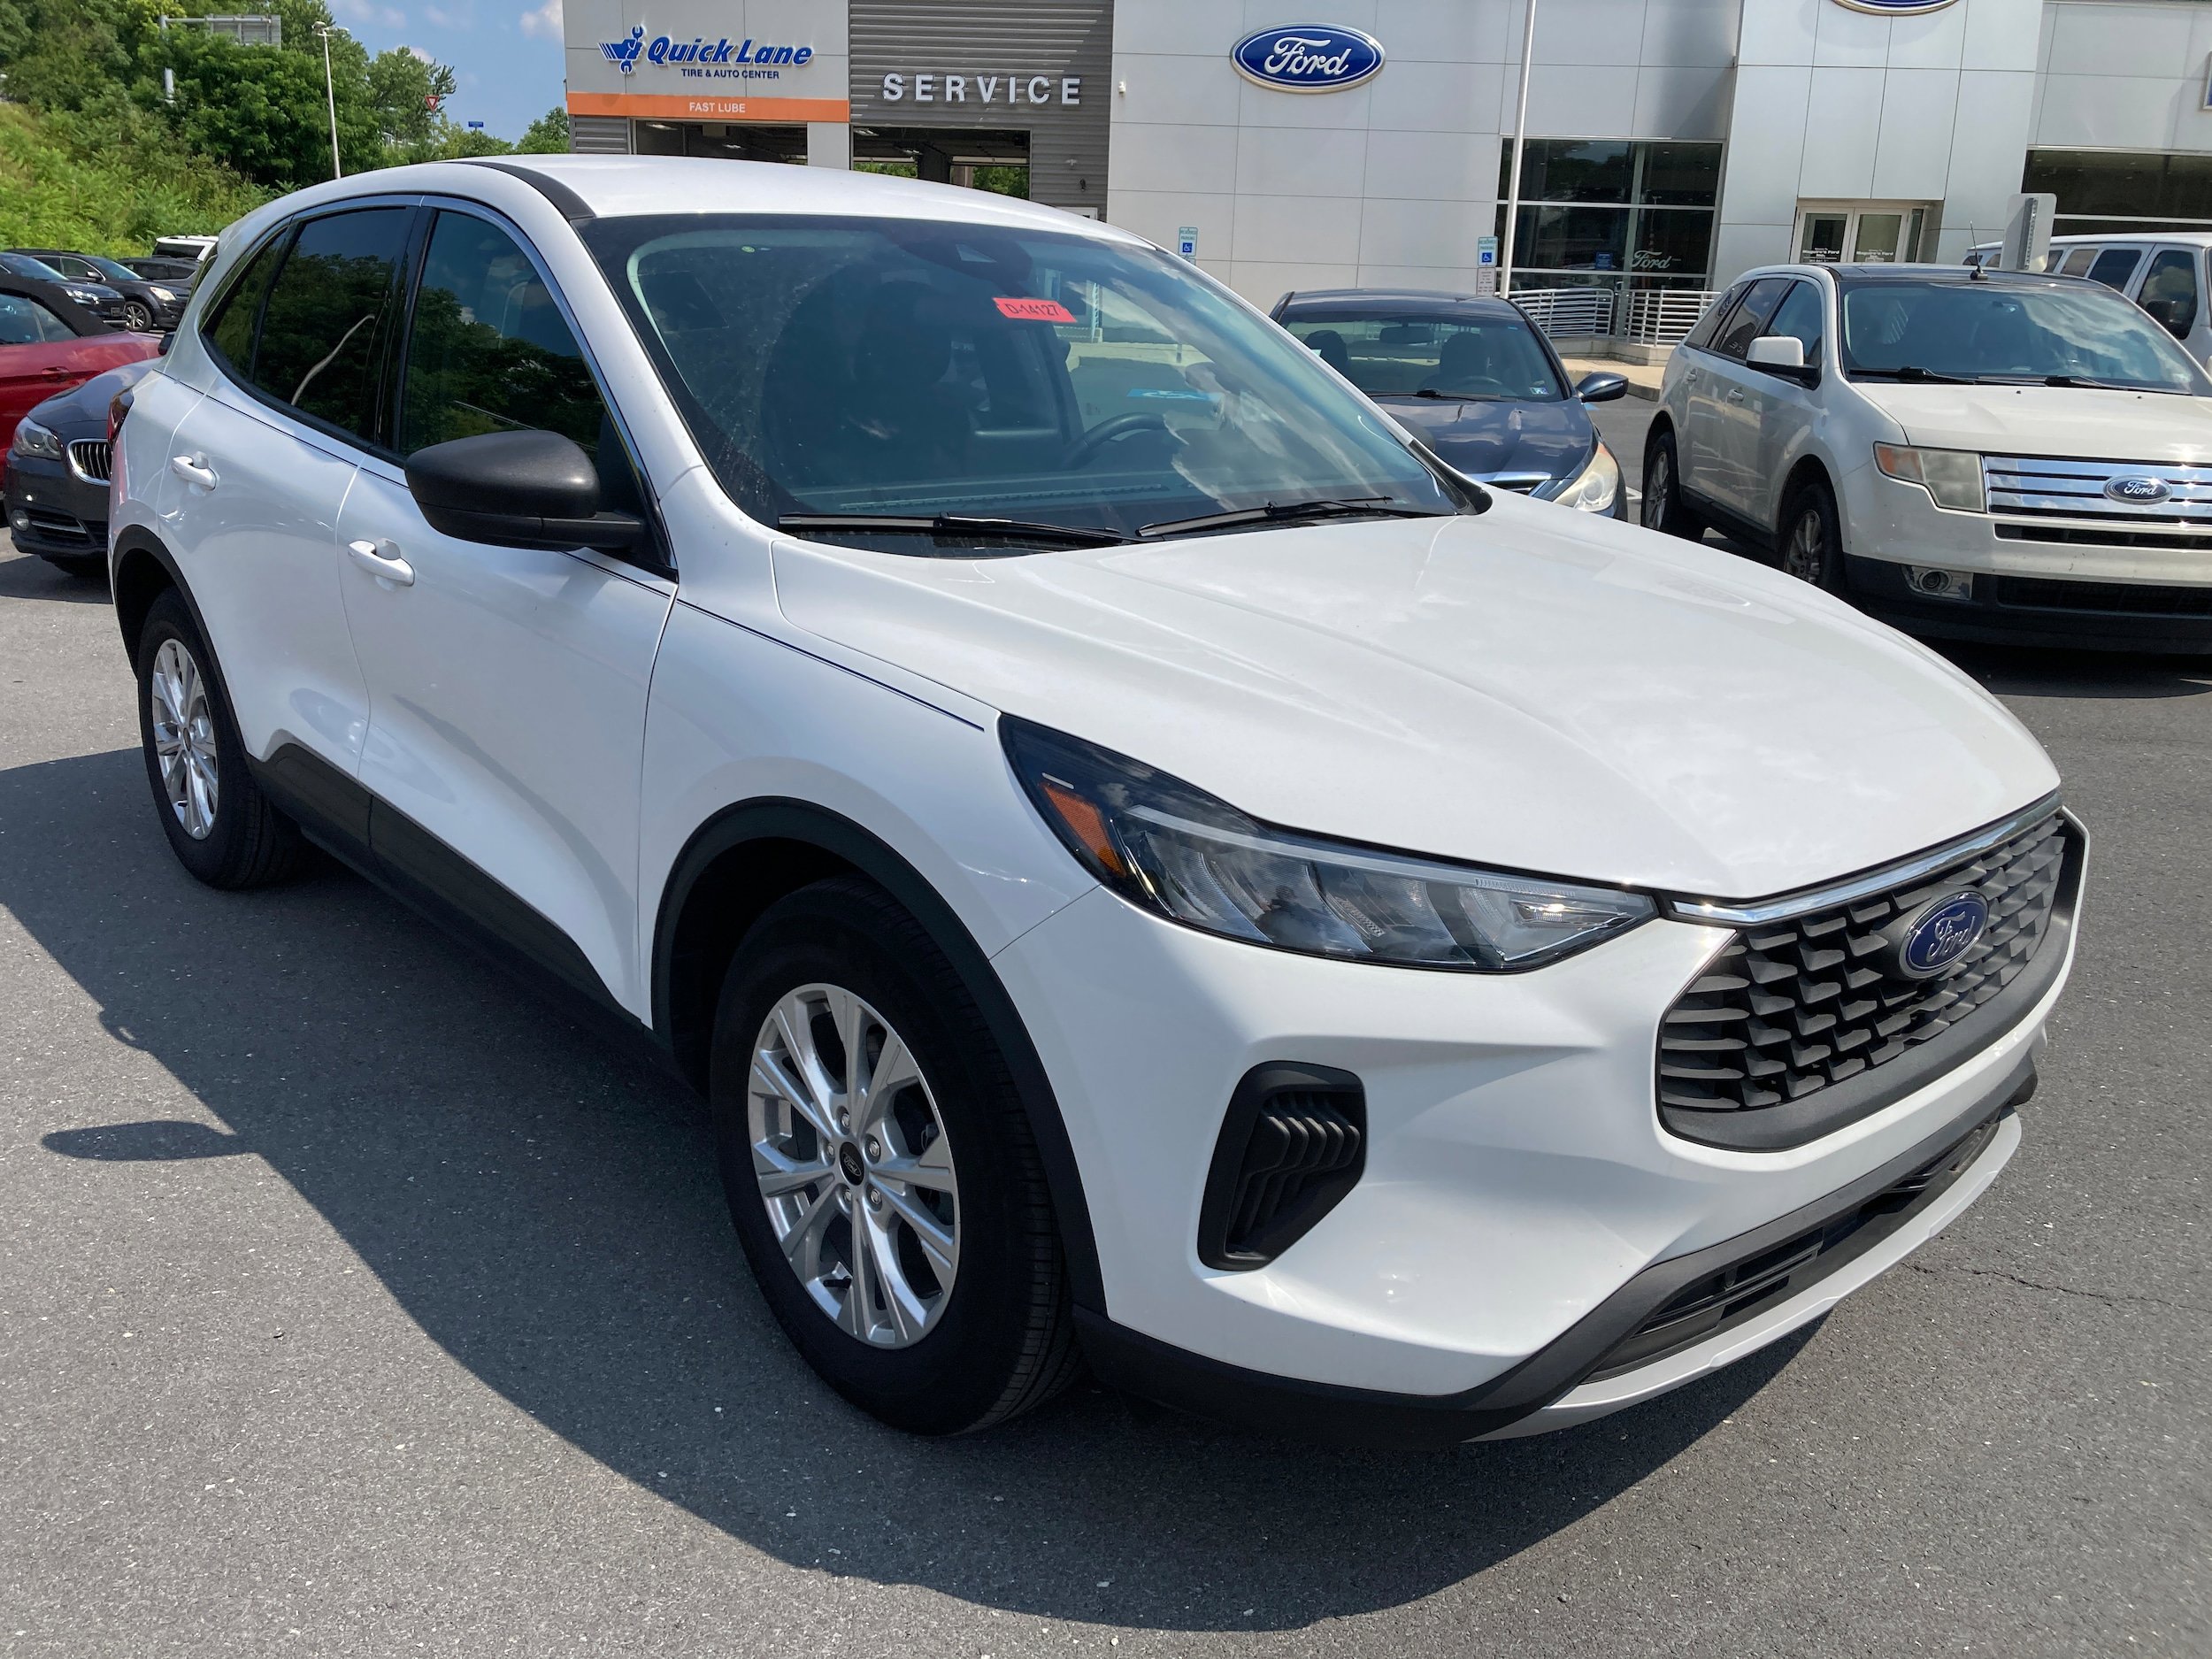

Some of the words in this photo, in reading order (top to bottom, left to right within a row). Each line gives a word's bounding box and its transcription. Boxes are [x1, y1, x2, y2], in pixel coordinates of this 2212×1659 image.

[648, 36, 734, 65] Quick
[735, 39, 813, 65] Lane
[1264, 37, 1352, 75] Ford
[681, 68, 703, 78] TIRE
[705, 69, 712, 78] &
[713, 69, 740, 79] AUTO
[741, 70, 780, 80] CENTER
[883, 73, 1080, 104] SERVICE
[689, 102, 715, 112] FAST
[718, 103, 746, 113] LUBE
[1631, 250, 1672, 269] Ford
[1004, 303, 1059, 316] D-14127
[2124, 480, 2158, 495] Ford
[1926, 910, 1976, 963] Ford
